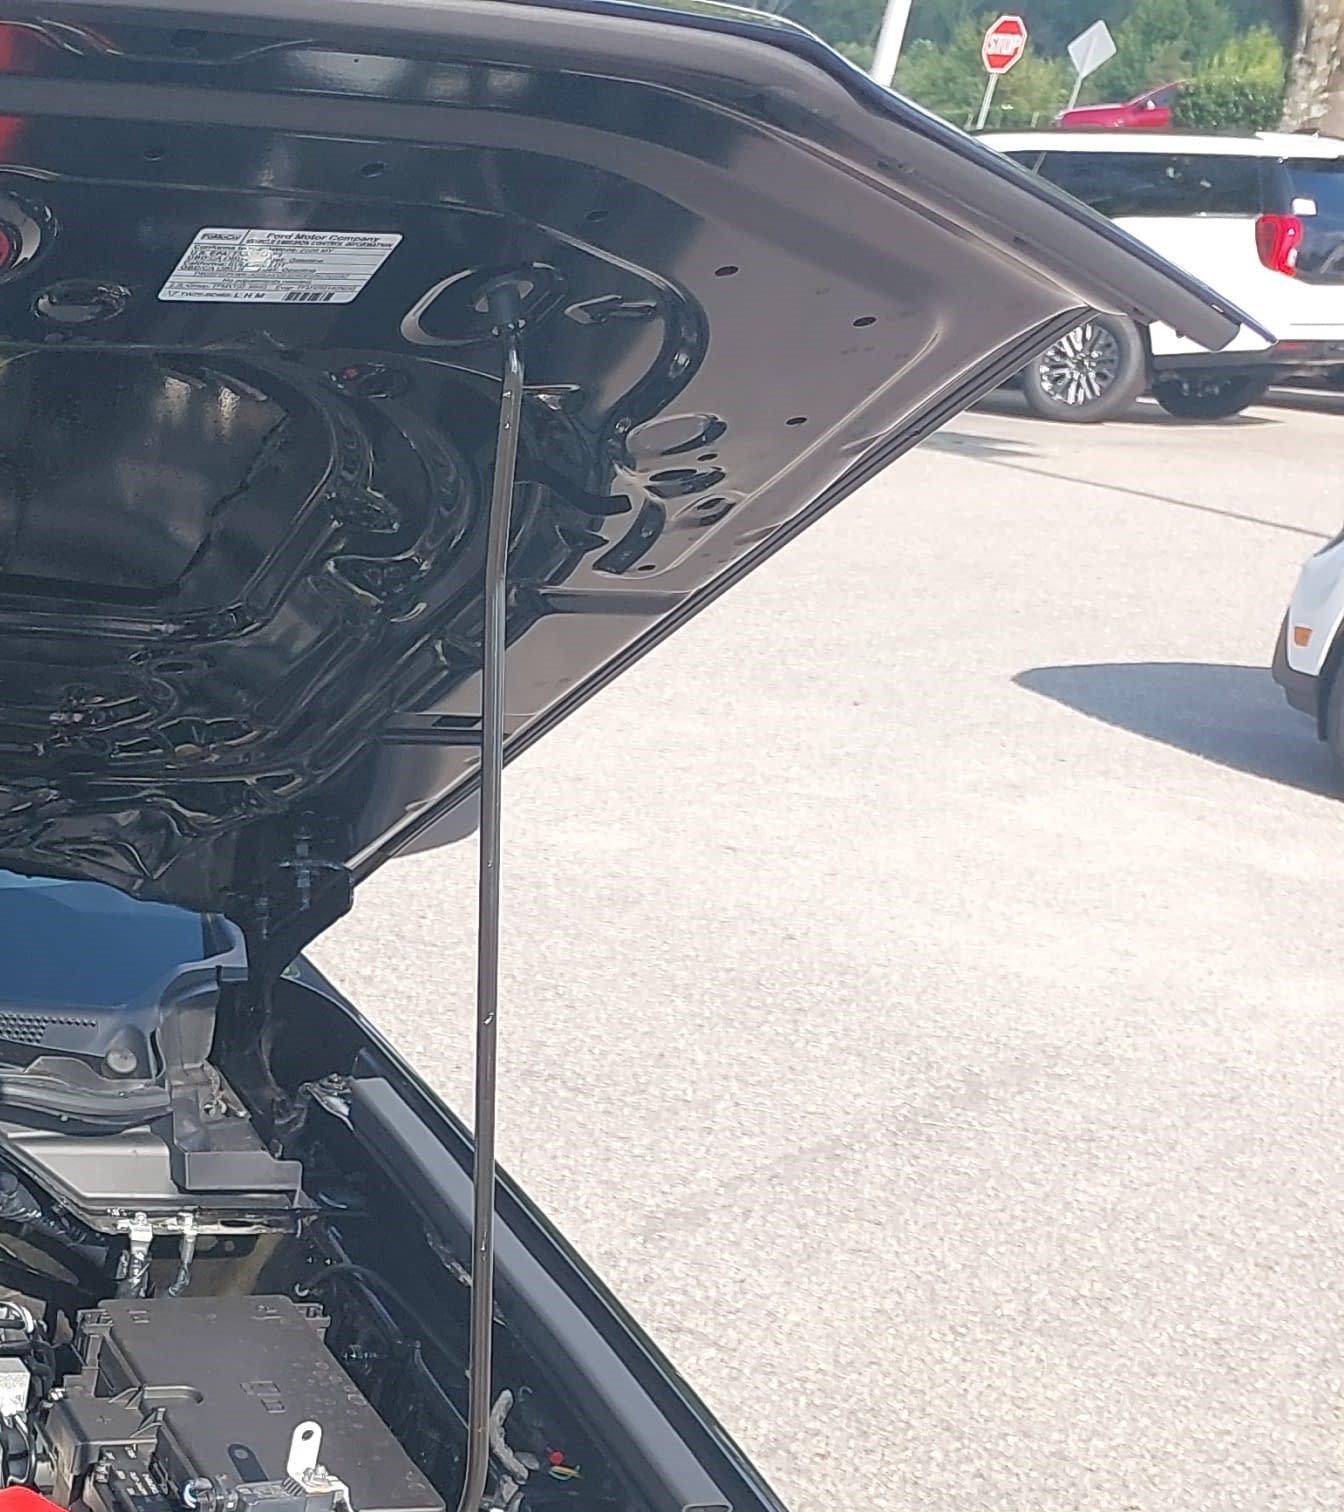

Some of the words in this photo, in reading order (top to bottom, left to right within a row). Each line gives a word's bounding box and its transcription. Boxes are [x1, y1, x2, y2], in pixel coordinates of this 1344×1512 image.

[986, 33, 1023, 56] STOP
[266, 232, 293, 241] Ford
[293, 233, 327, 242] Motor
[328, 234, 382, 243] Company
